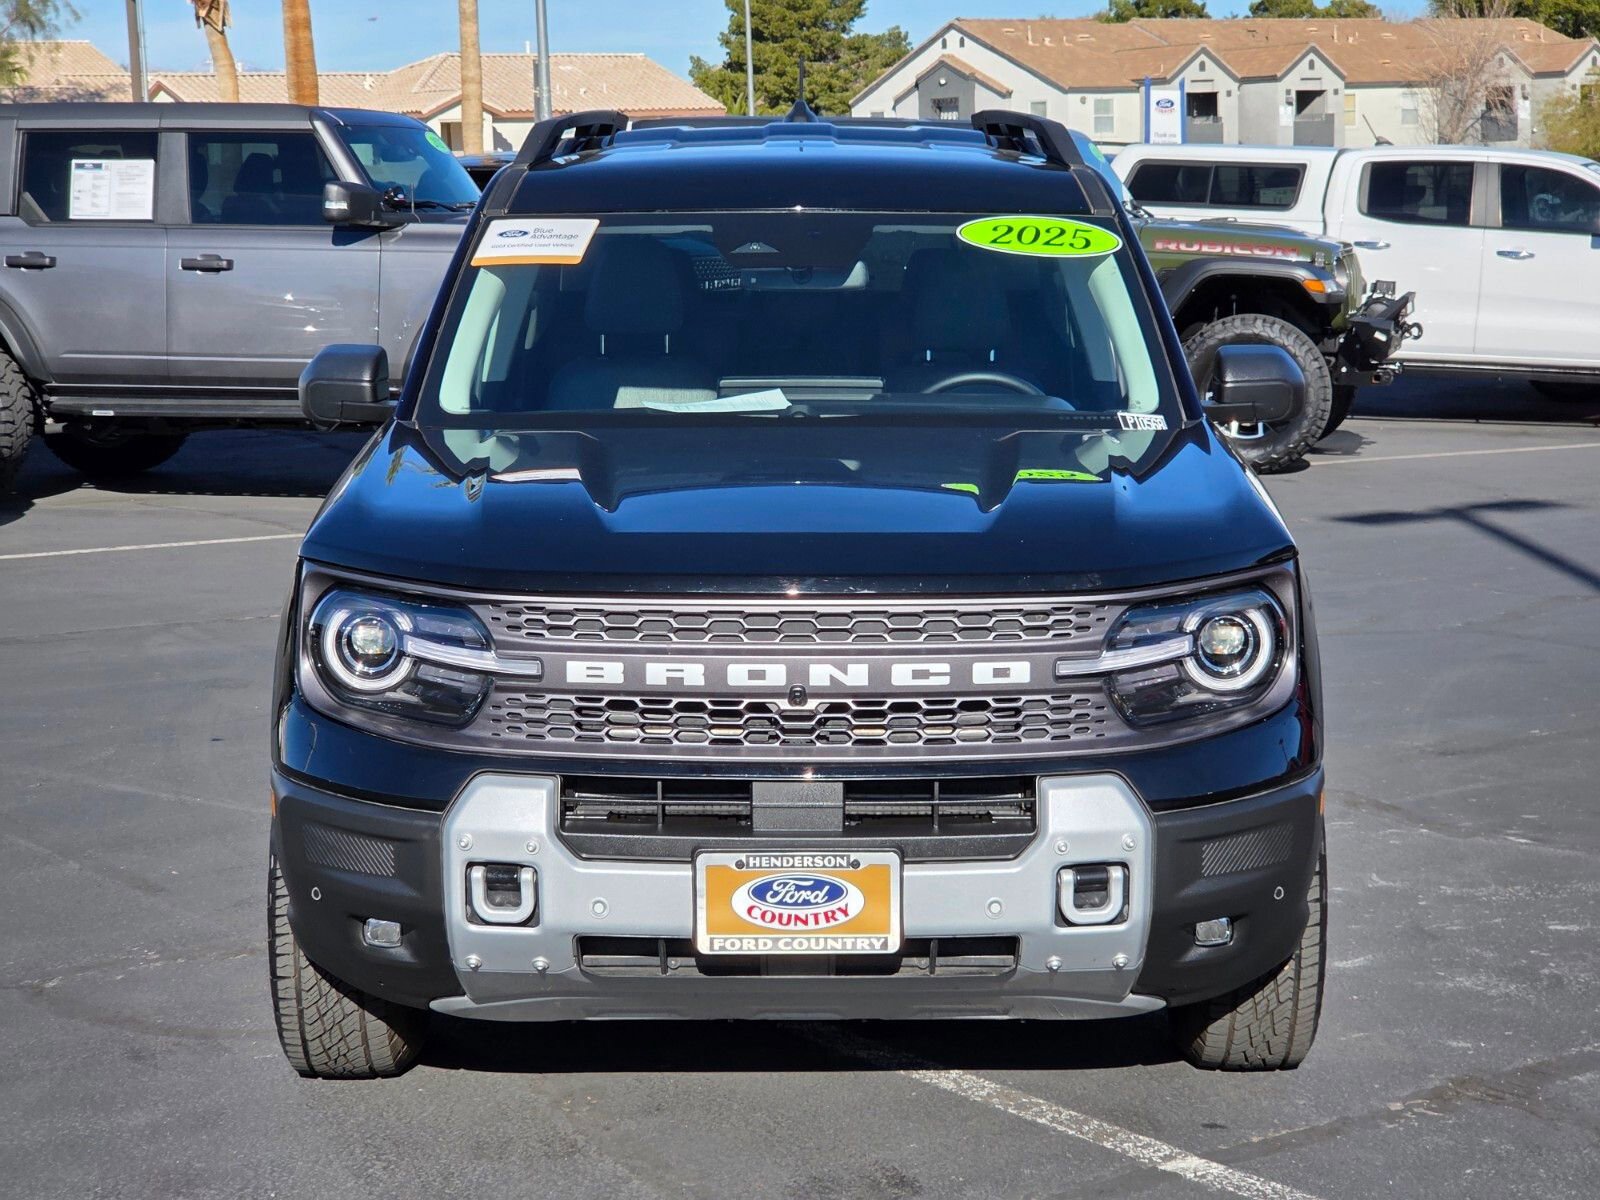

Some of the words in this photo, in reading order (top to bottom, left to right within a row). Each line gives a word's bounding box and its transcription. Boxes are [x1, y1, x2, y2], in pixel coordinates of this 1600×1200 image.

[989, 224, 1093, 250] 2025
[1154, 239, 1299, 257] RUBICON
[566, 660, 1031, 686] BRONCO
[749, 856, 848, 868] HENDERSON
[766, 879, 829, 904] Ford
[746, 903, 850, 927] COUNTRY
[712, 938, 773, 951] FORD
[777, 937, 886, 951] COUNTRY
